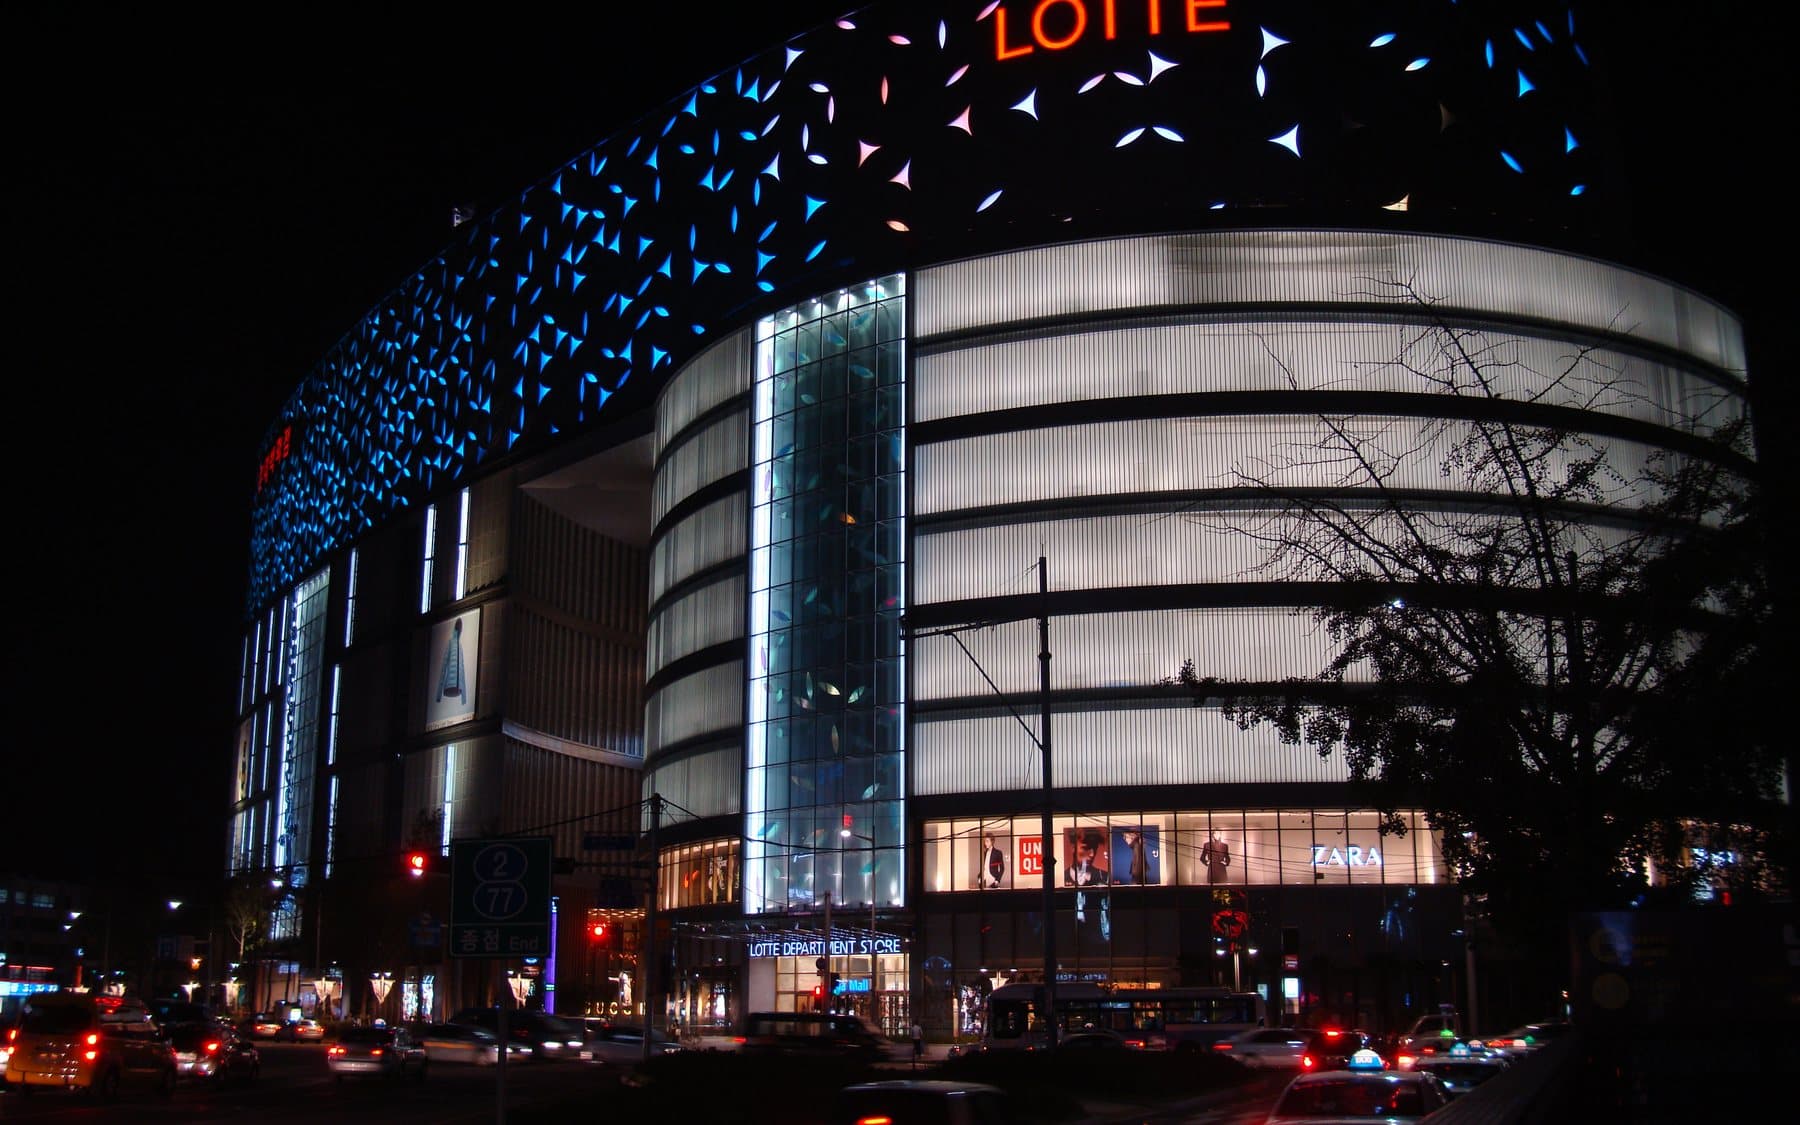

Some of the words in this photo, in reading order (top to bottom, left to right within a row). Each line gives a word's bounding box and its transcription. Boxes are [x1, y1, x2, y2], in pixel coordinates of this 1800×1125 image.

[1023, 842, 1042, 855] UN
[1310, 846, 1382, 866] ZARA
[493, 851, 507, 877] 2
[1023, 857, 1042, 873] QL
[487, 887, 515, 913] 77
[460, 928, 500, 953] 종점
[510, 935, 539, 952] End
[750, 942, 780, 957] LOTTE
[783, 940, 857, 956] DEPARTMENT
[860, 938, 901, 954] STORE
